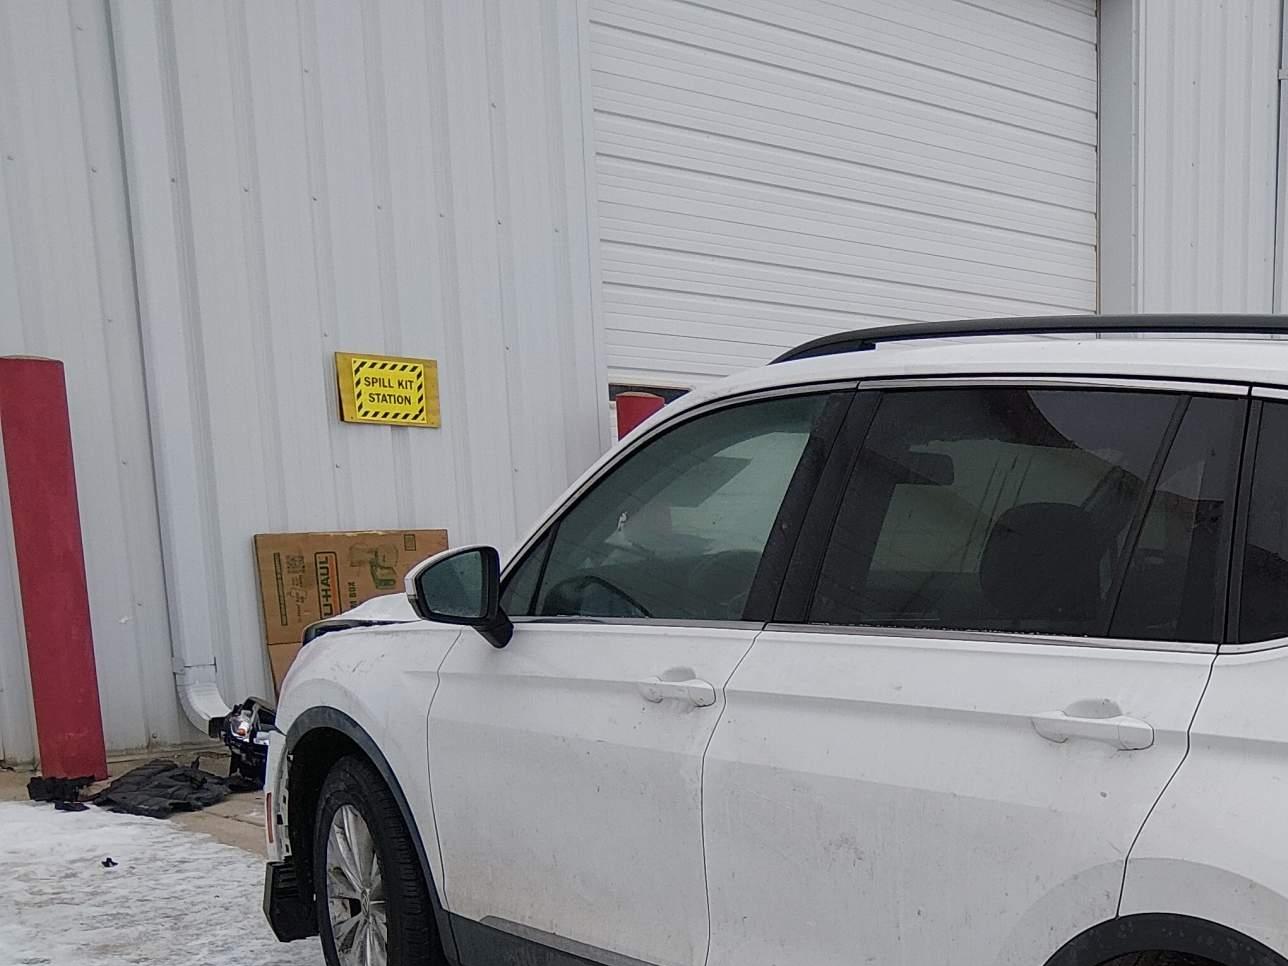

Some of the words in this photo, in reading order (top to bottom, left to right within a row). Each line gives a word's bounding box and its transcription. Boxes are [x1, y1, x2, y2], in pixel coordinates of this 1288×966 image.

[363, 376, 394, 389] SPILL
[397, 379, 414, 390] KIT
[368, 392, 412, 405] STATION
[318, 556, 333, 616] U-HAUL
